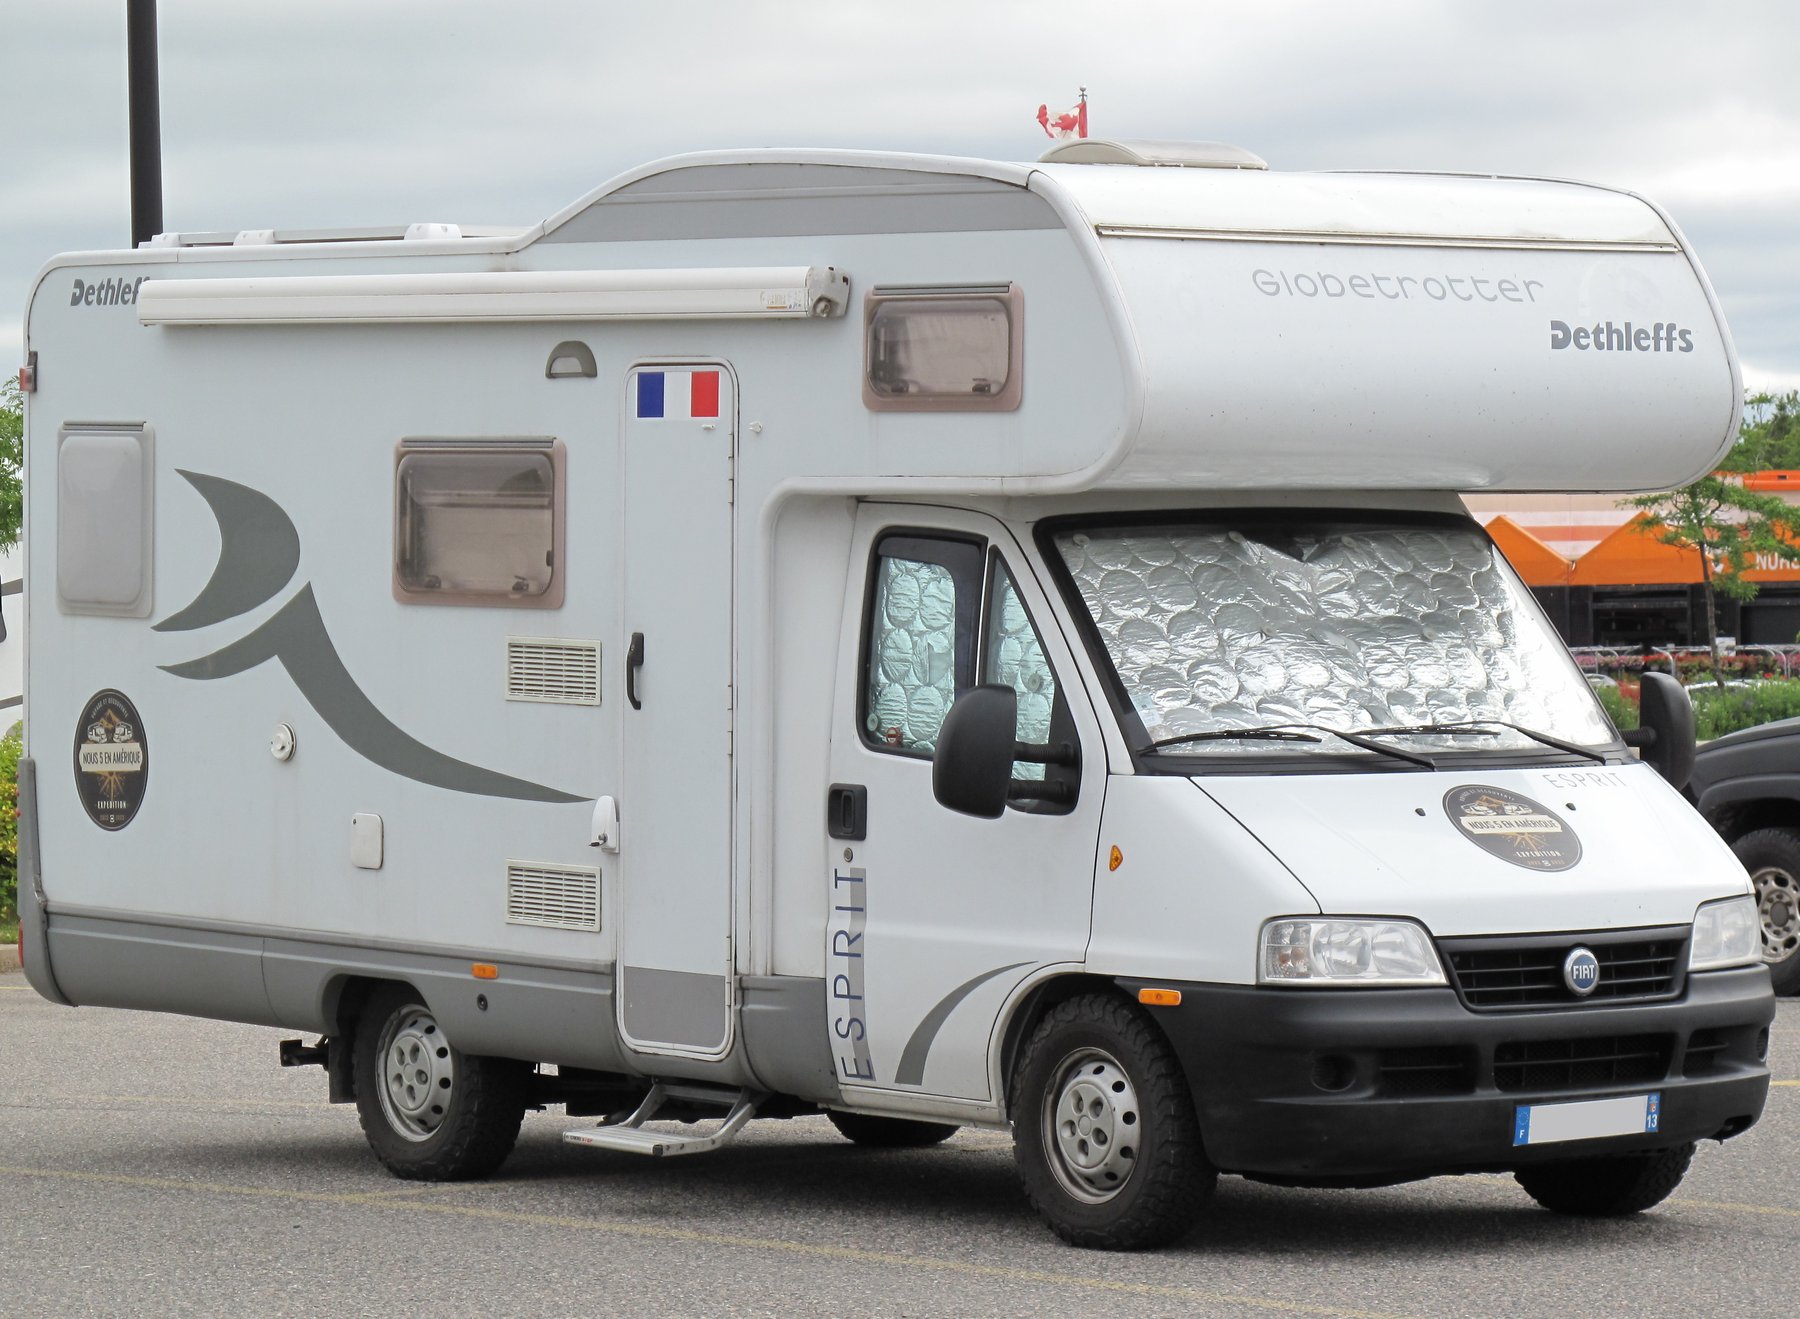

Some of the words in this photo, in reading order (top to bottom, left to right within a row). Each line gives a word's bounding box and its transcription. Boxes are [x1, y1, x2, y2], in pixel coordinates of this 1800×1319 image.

[70, 276, 150, 306] Dethlef
[1252, 269, 1544, 303] Globetrotter
[1550, 320, 1694, 353] Dethleffs
[82, 752, 98, 765] NOUS
[99, 752, 104, 765] 5
[104, 752, 112, 765] EN
[112, 748, 141, 766] AMÉRIQUE
[1542, 773, 1626, 789] ESPRIT
[1468, 820, 1494, 830] NOUS
[1494, 820, 1502, 829] 5
[1502, 820, 1515, 829] EN
[1515, 818, 1559, 829] AMÉRIQUE
[833, 868, 873, 1080] ESPRIT
[1573, 964, 1595, 980] FIAT
[1646, 1114, 1658, 1128] 13
[1519, 1129, 1525, 1139] F
